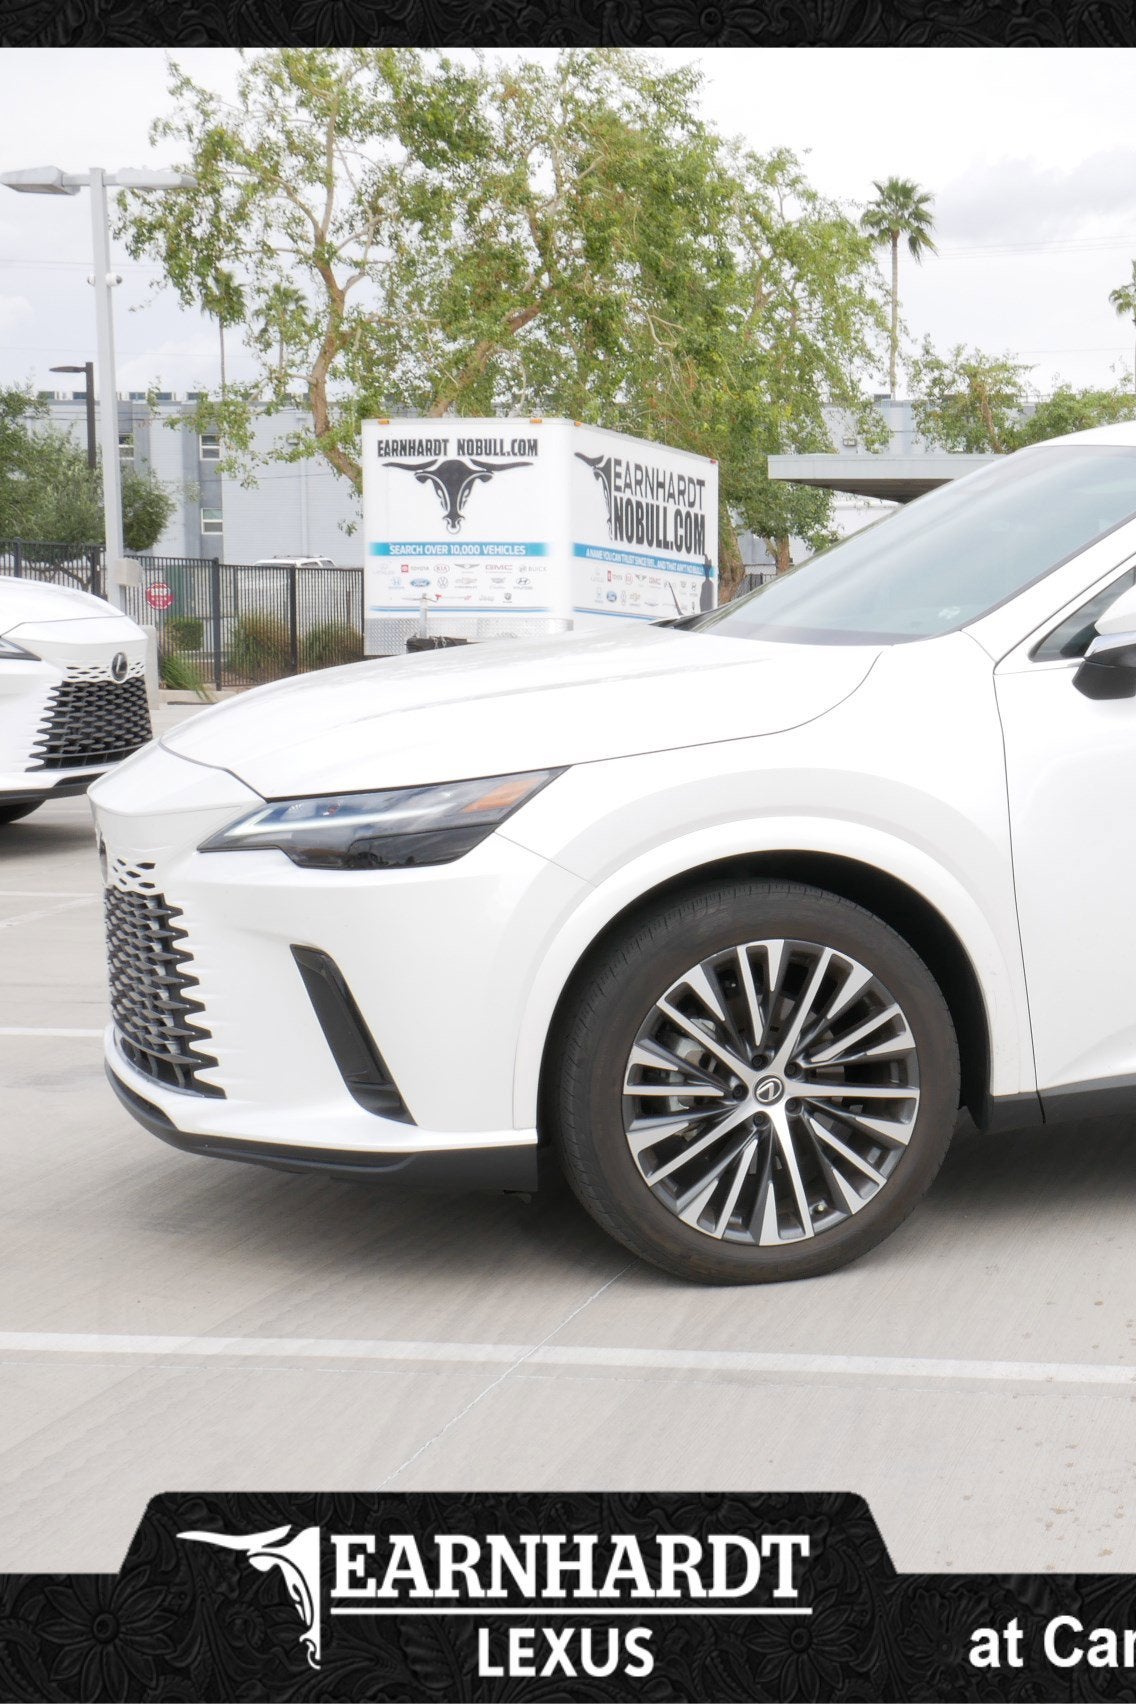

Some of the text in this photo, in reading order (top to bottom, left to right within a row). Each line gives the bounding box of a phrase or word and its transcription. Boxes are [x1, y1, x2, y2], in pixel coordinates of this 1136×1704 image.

[377, 438, 538, 457] EARNHARDT NOBULL.COM
[613, 458, 705, 510] EARNHARDT
[613, 495, 705, 556] NOBULL.COM
[389, 544, 526, 555] SEARCH OVER 10,000 VEHICLES
